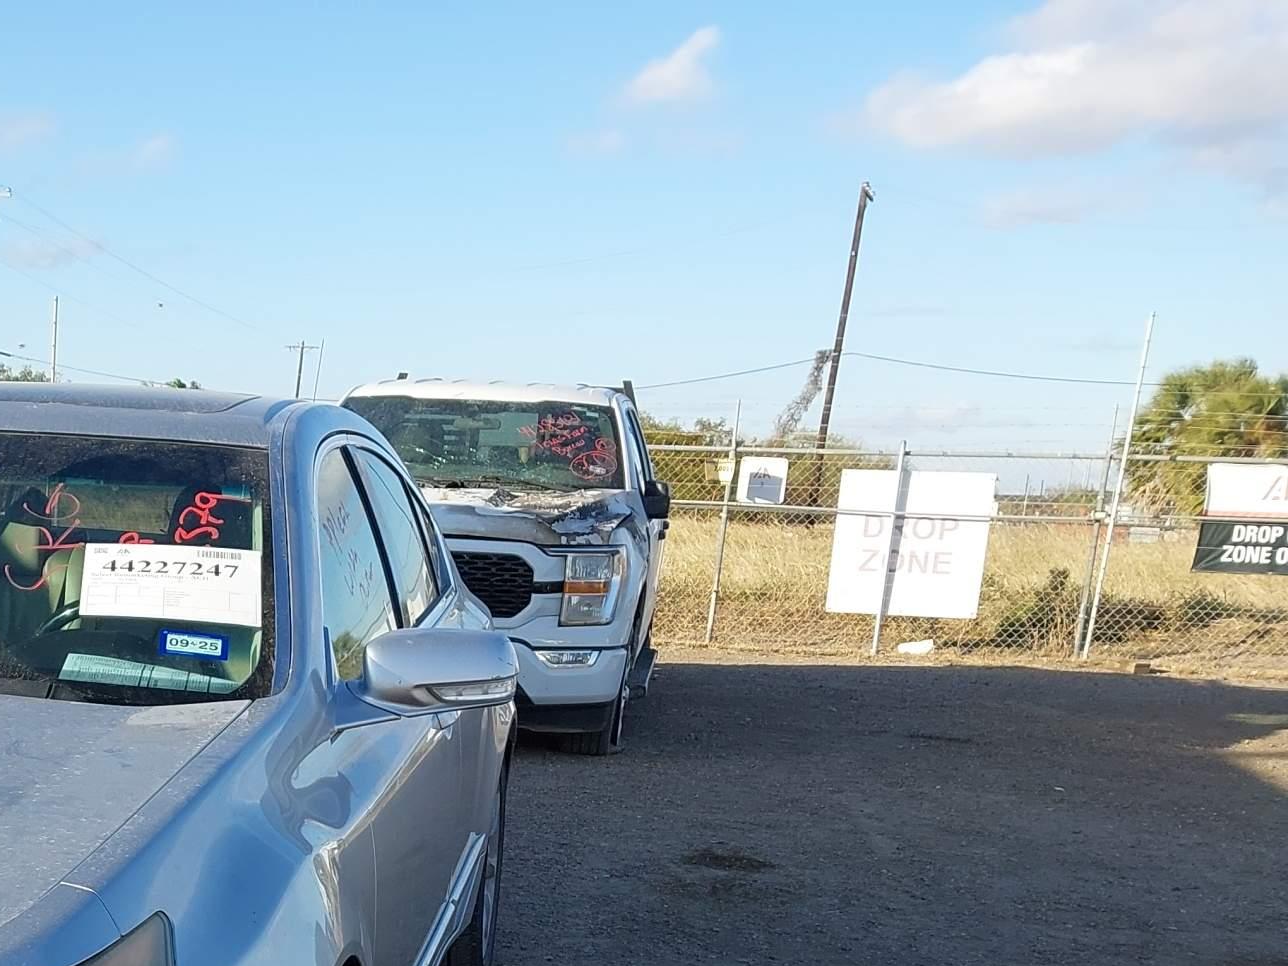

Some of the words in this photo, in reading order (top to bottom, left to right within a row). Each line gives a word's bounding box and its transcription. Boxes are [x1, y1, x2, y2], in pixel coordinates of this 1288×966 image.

[862, 516, 960, 541] DROP
[1231, 524, 1284, 544] DROP
[858, 548, 953, 575] ZONE
[1220, 544, 1273, 565] ZONE
[102, 559, 239, 578] 44227247
